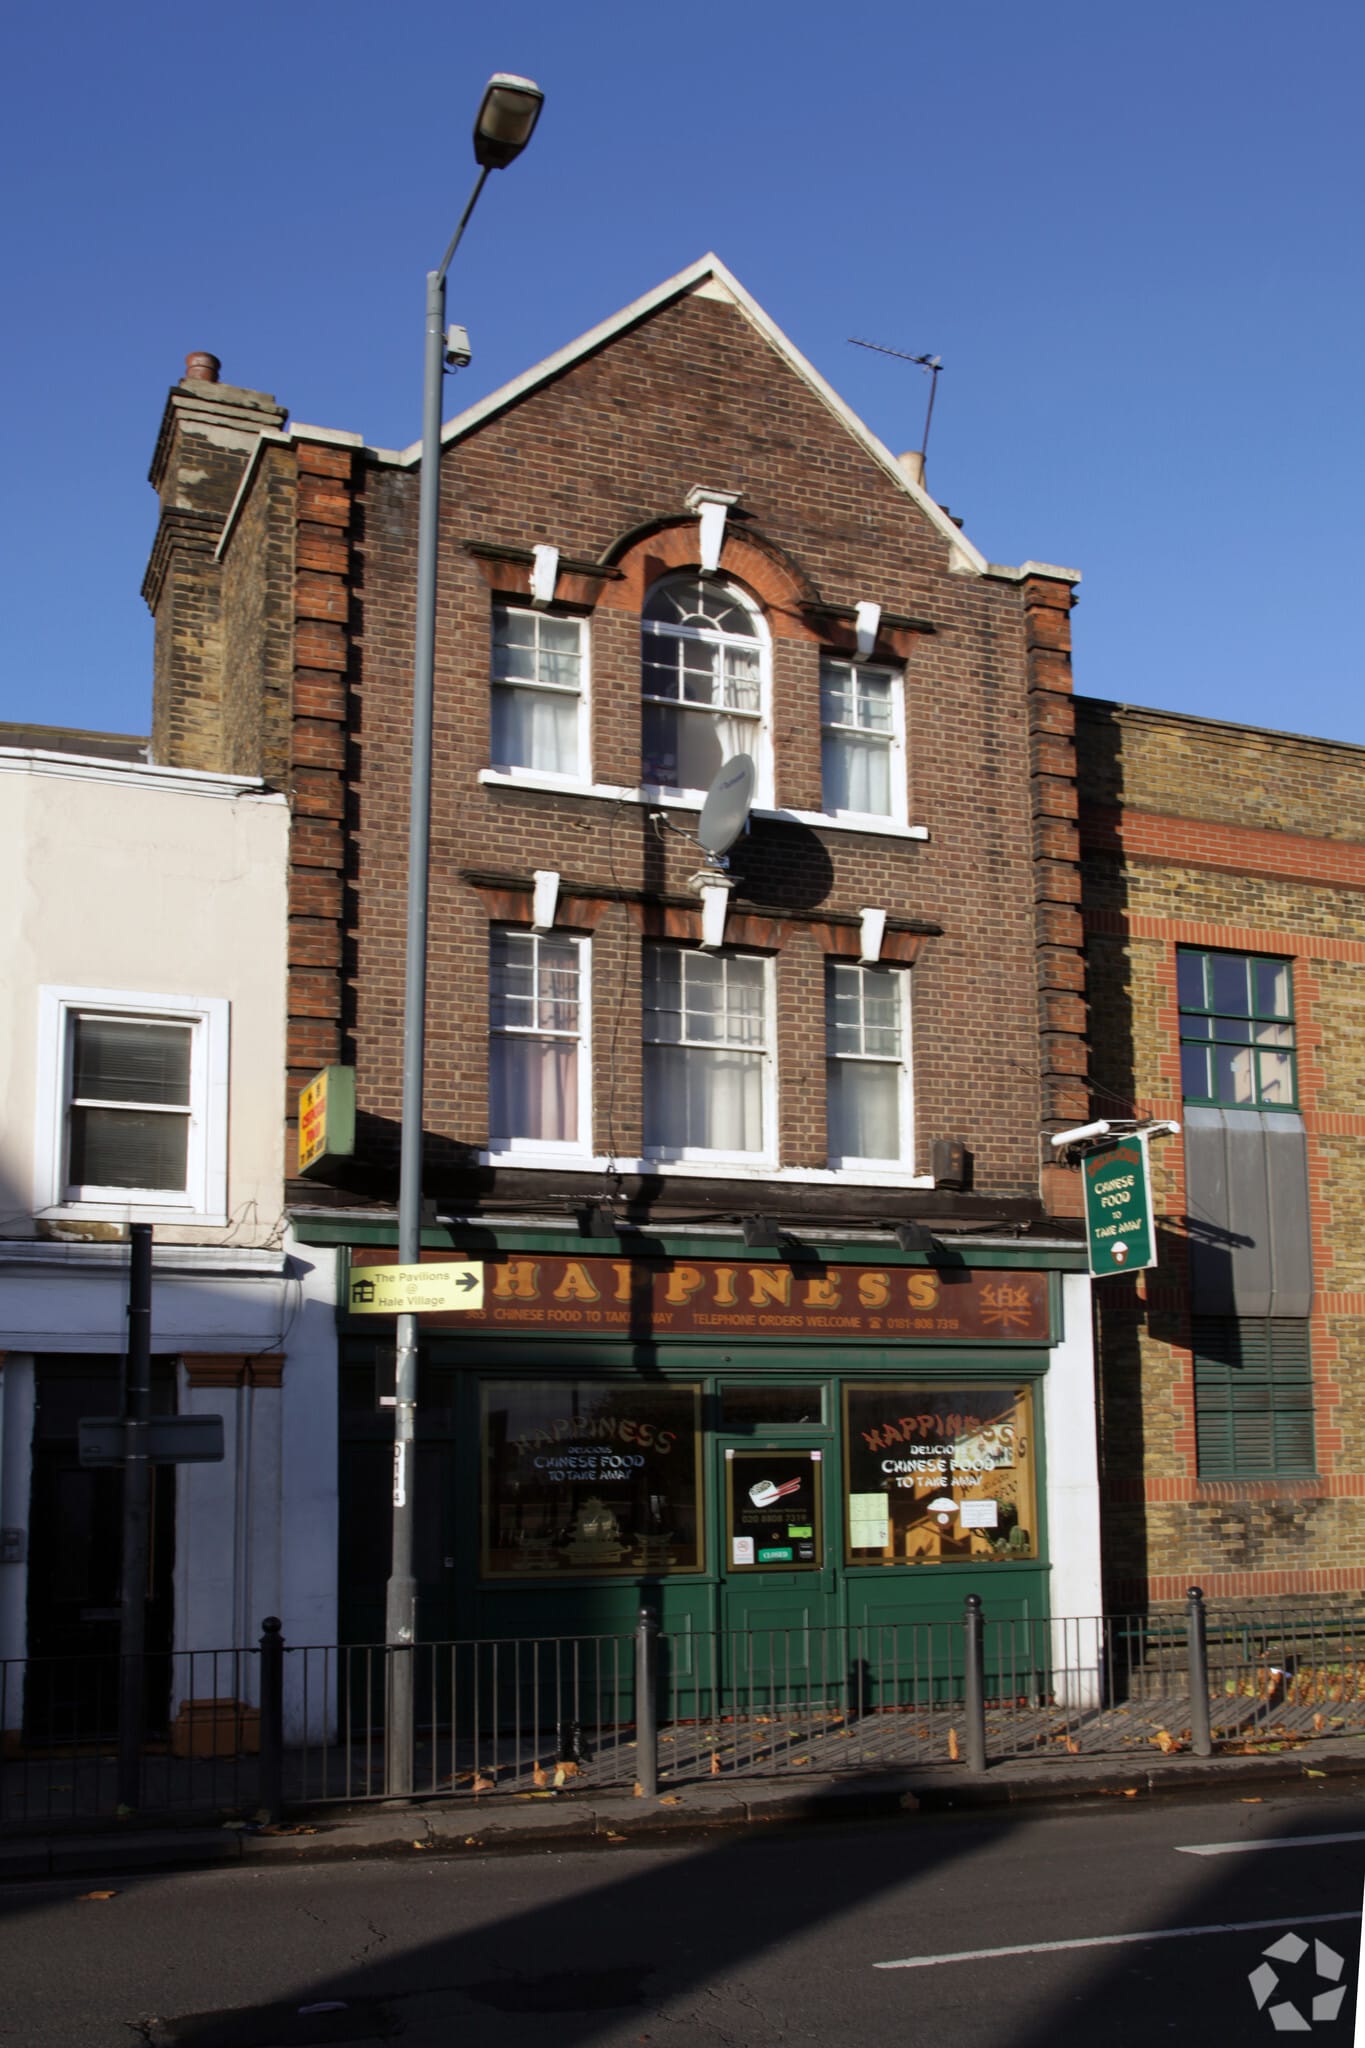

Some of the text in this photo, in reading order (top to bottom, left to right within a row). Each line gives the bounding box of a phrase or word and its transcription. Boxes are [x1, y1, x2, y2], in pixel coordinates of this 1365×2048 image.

[1094, 1174, 1135, 1195] CHINESE
[1101, 1191, 1131, 1208] FOOD
[1112, 1211, 1122, 1219] TO
[1094, 1218, 1142, 1239] TAKE AWAY
[375, 1272, 450, 1283] The Pavilions
[406, 1284, 417, 1294] @
[379, 1296, 445, 1307] Hale Village
[494, 1308, 544, 1321] CHINESE
[547, 1309, 582, 1322] FOOD
[586, 1310, 601, 1322] TO
[693, 1313, 755, 1326] TELEPHONE
[758, 1315, 803, 1327] ORDERS
[807, 1316, 862, 1328] WELCOME
[861, 1413, 1017, 1453] HAPPINESS
[533, 1455, 646, 1469] CHINESE FOOD
[881, 1459, 996, 1473] CHINESE FOOD
[548, 1469, 633, 1481] TO TAKE AWAY
[896, 1475, 984, 1488] TO TAKE AWAY
